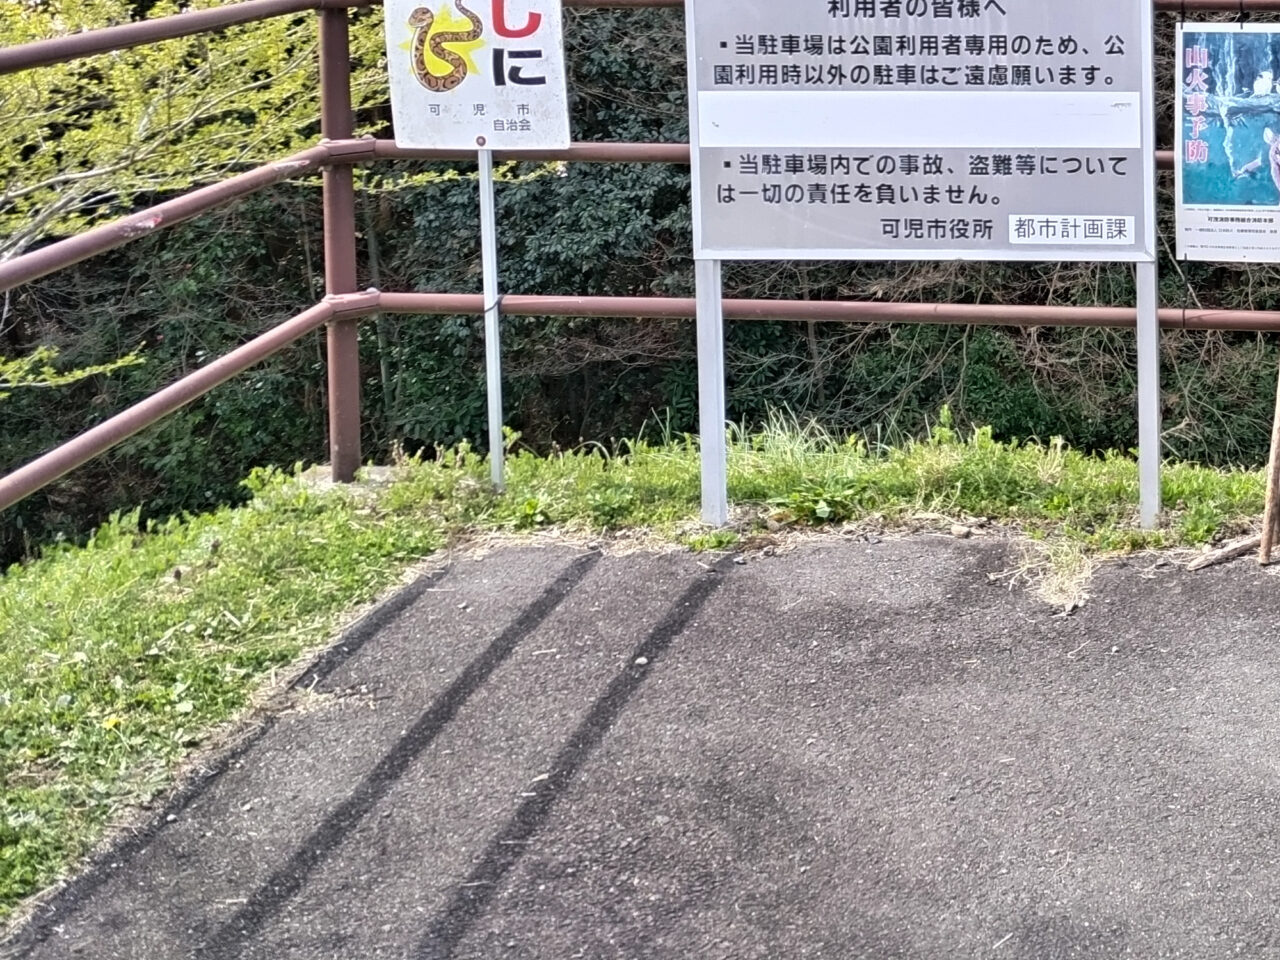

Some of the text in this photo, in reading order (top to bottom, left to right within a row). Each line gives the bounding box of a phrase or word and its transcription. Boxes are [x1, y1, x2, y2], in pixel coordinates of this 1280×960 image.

[713, 64, 1115, 87] 園利用時以外の駐車はご遠慮願います。
[428, 103, 530, 116] 可児市
[1185, 45, 1209, 163] 山火事予防
[493, 119, 531, 132] 自治会
[717, 183, 1002, 204] は一切の責任を負いません。
[881, 217, 1129, 240] 可児市役所 都市計画課
